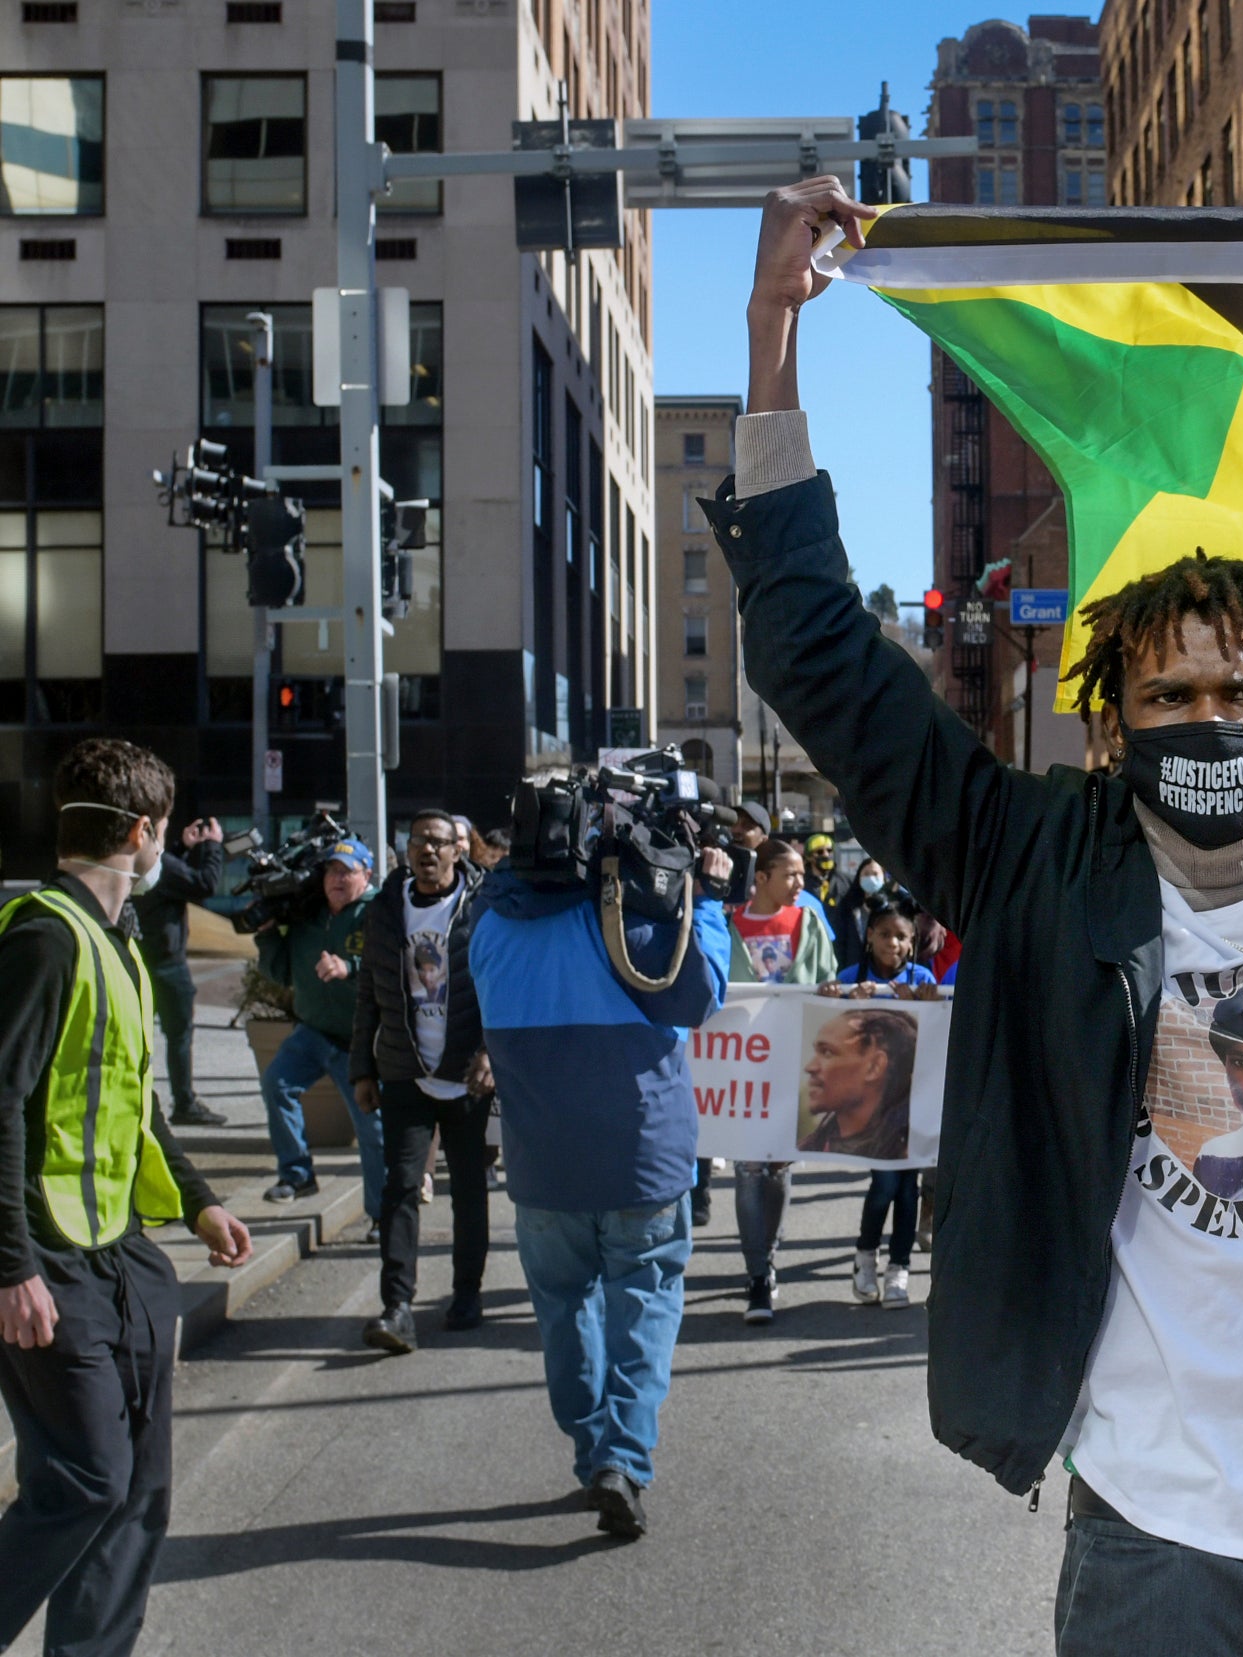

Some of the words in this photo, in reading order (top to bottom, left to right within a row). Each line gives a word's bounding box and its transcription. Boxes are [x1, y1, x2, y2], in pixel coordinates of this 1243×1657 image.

[966, 602, 984, 610] NO
[1019, 605, 1062, 620] Grant
[960, 612, 991, 623] TURN
[963, 633, 987, 643] RED
[692, 1026, 771, 1063] ime
[693, 1079, 771, 1119] w!!!
